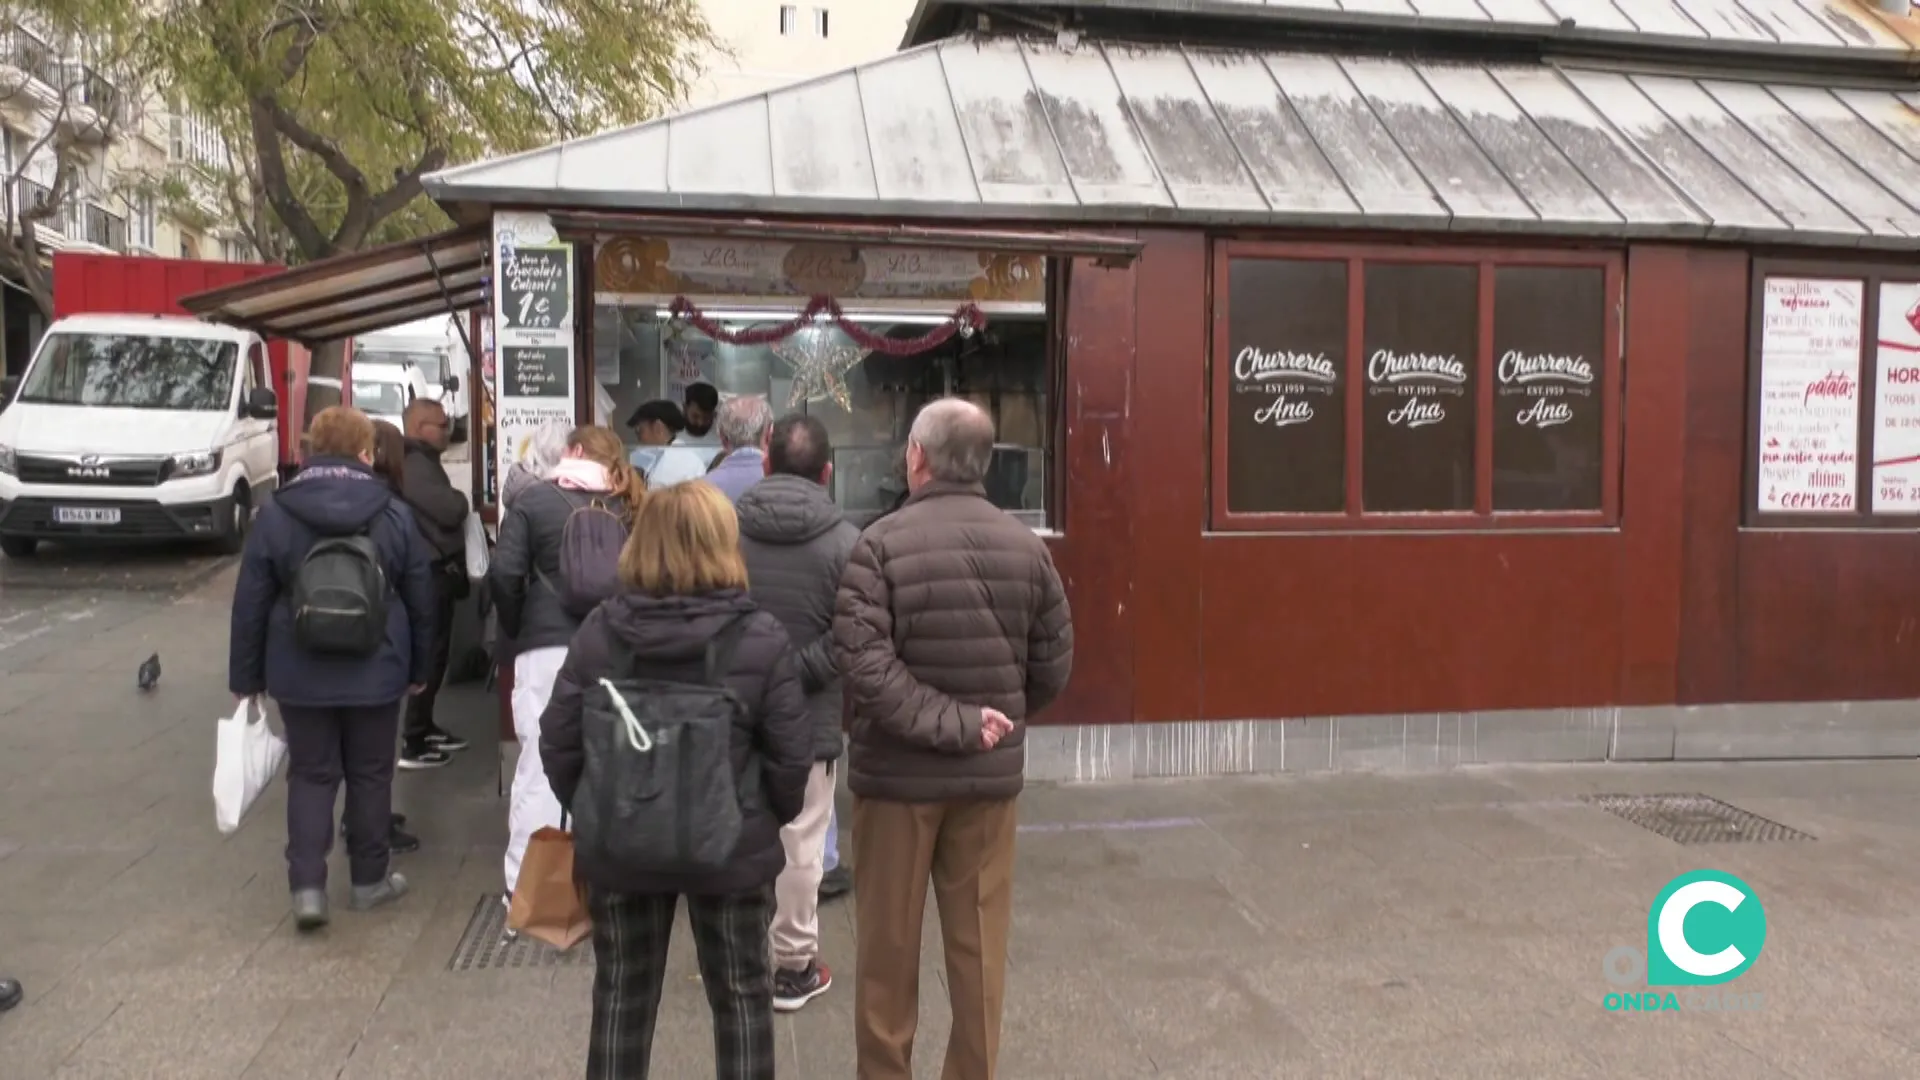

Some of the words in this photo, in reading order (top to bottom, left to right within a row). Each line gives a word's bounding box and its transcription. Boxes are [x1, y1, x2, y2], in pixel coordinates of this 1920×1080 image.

[511, 276, 557, 292] Caliente
[1803, 369, 1856, 408] patatas
[1884, 393, 1916, 406] TODOS
[1254, 395, 1314, 426] Ana
[1387, 397, 1445, 428] Ana
[1516, 397, 1573, 428] Ana
[67, 466, 110, 477] MAN
[1781, 491, 1853, 509] cerveza
[1880, 487, 1904, 501] 956
